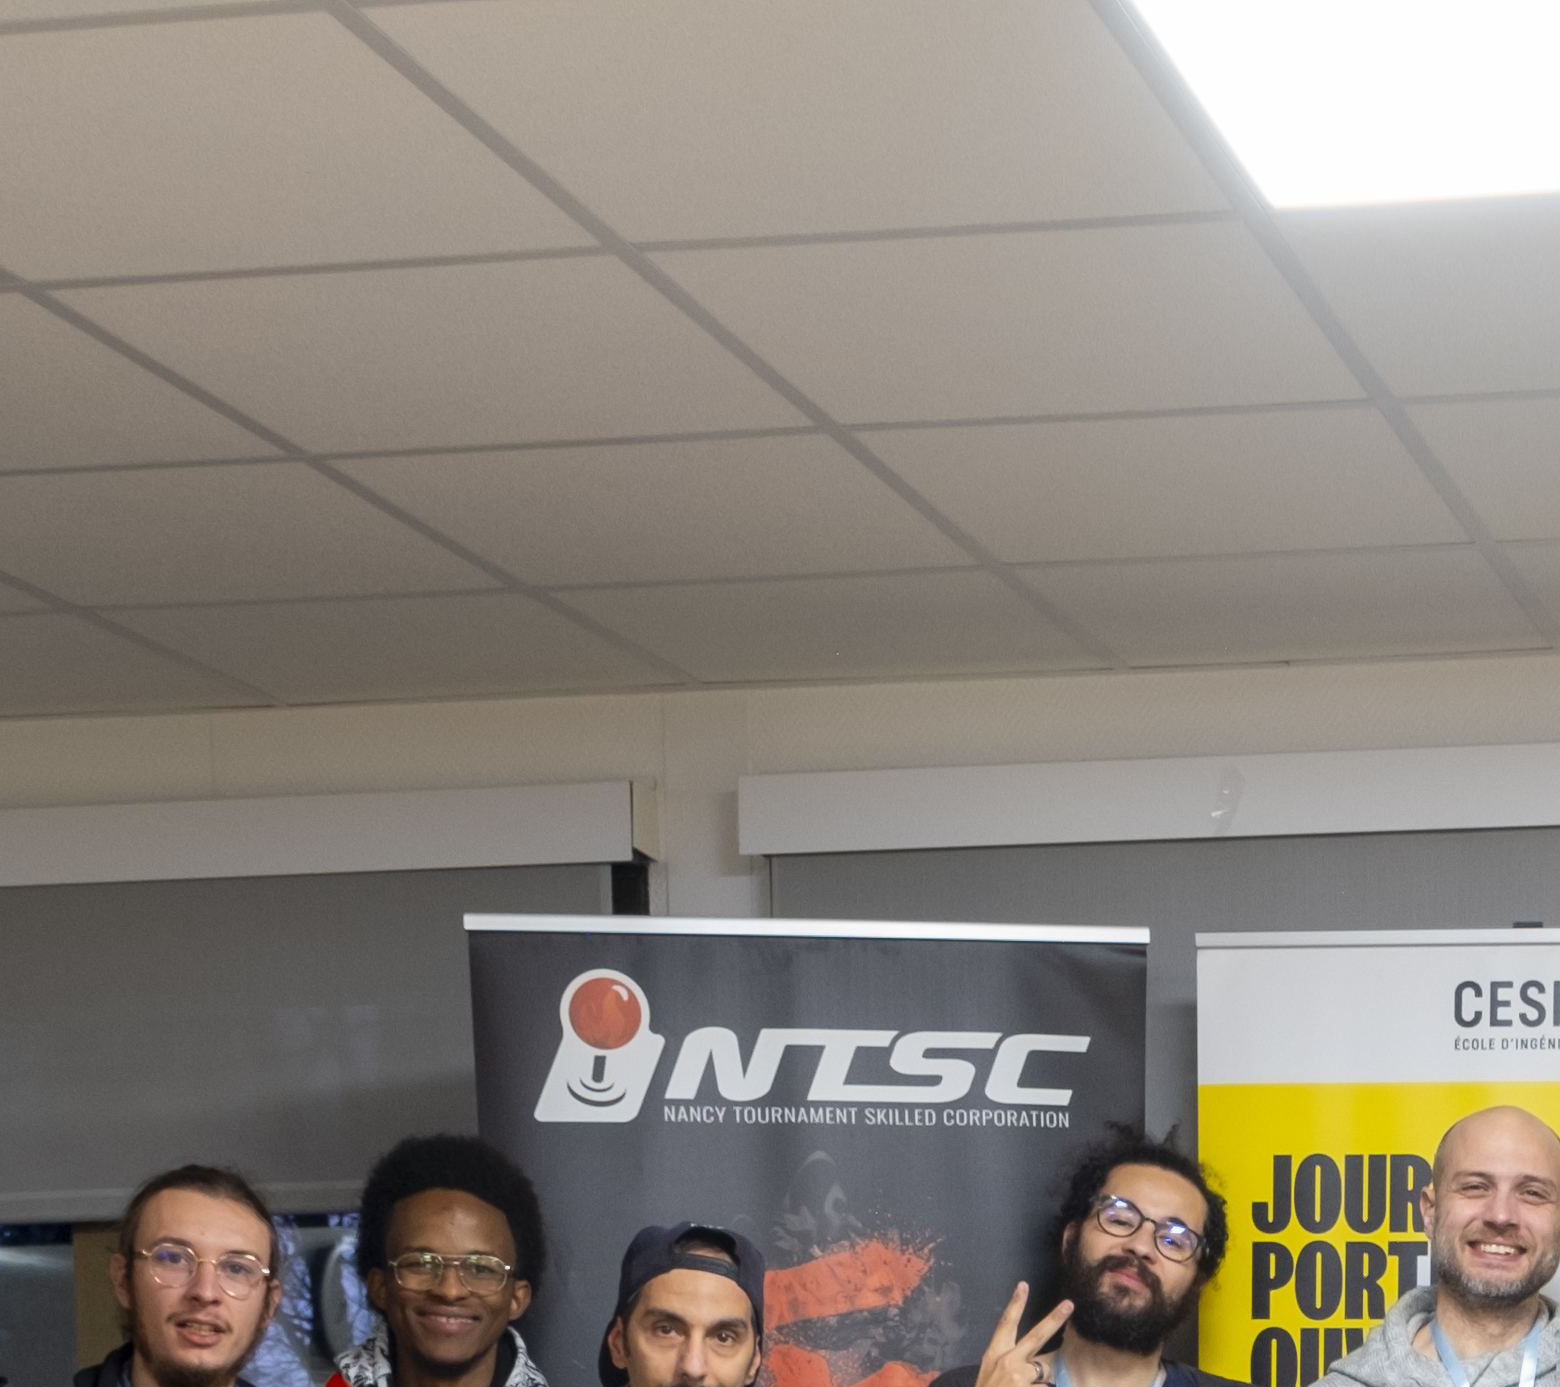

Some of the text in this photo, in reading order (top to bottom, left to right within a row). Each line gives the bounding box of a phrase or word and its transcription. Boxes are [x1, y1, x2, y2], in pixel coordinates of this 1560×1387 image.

[664, 1026, 1091, 1106] NTSC
[1454, 1034, 1496, 1051] ÉCOLE
[663, 1104, 1071, 1129] NANCY TOURNAMENT SKILLED CORPORATION
[1251, 1153, 1433, 1235] JOUR
[1251, 1240, 1429, 1321] PORT
